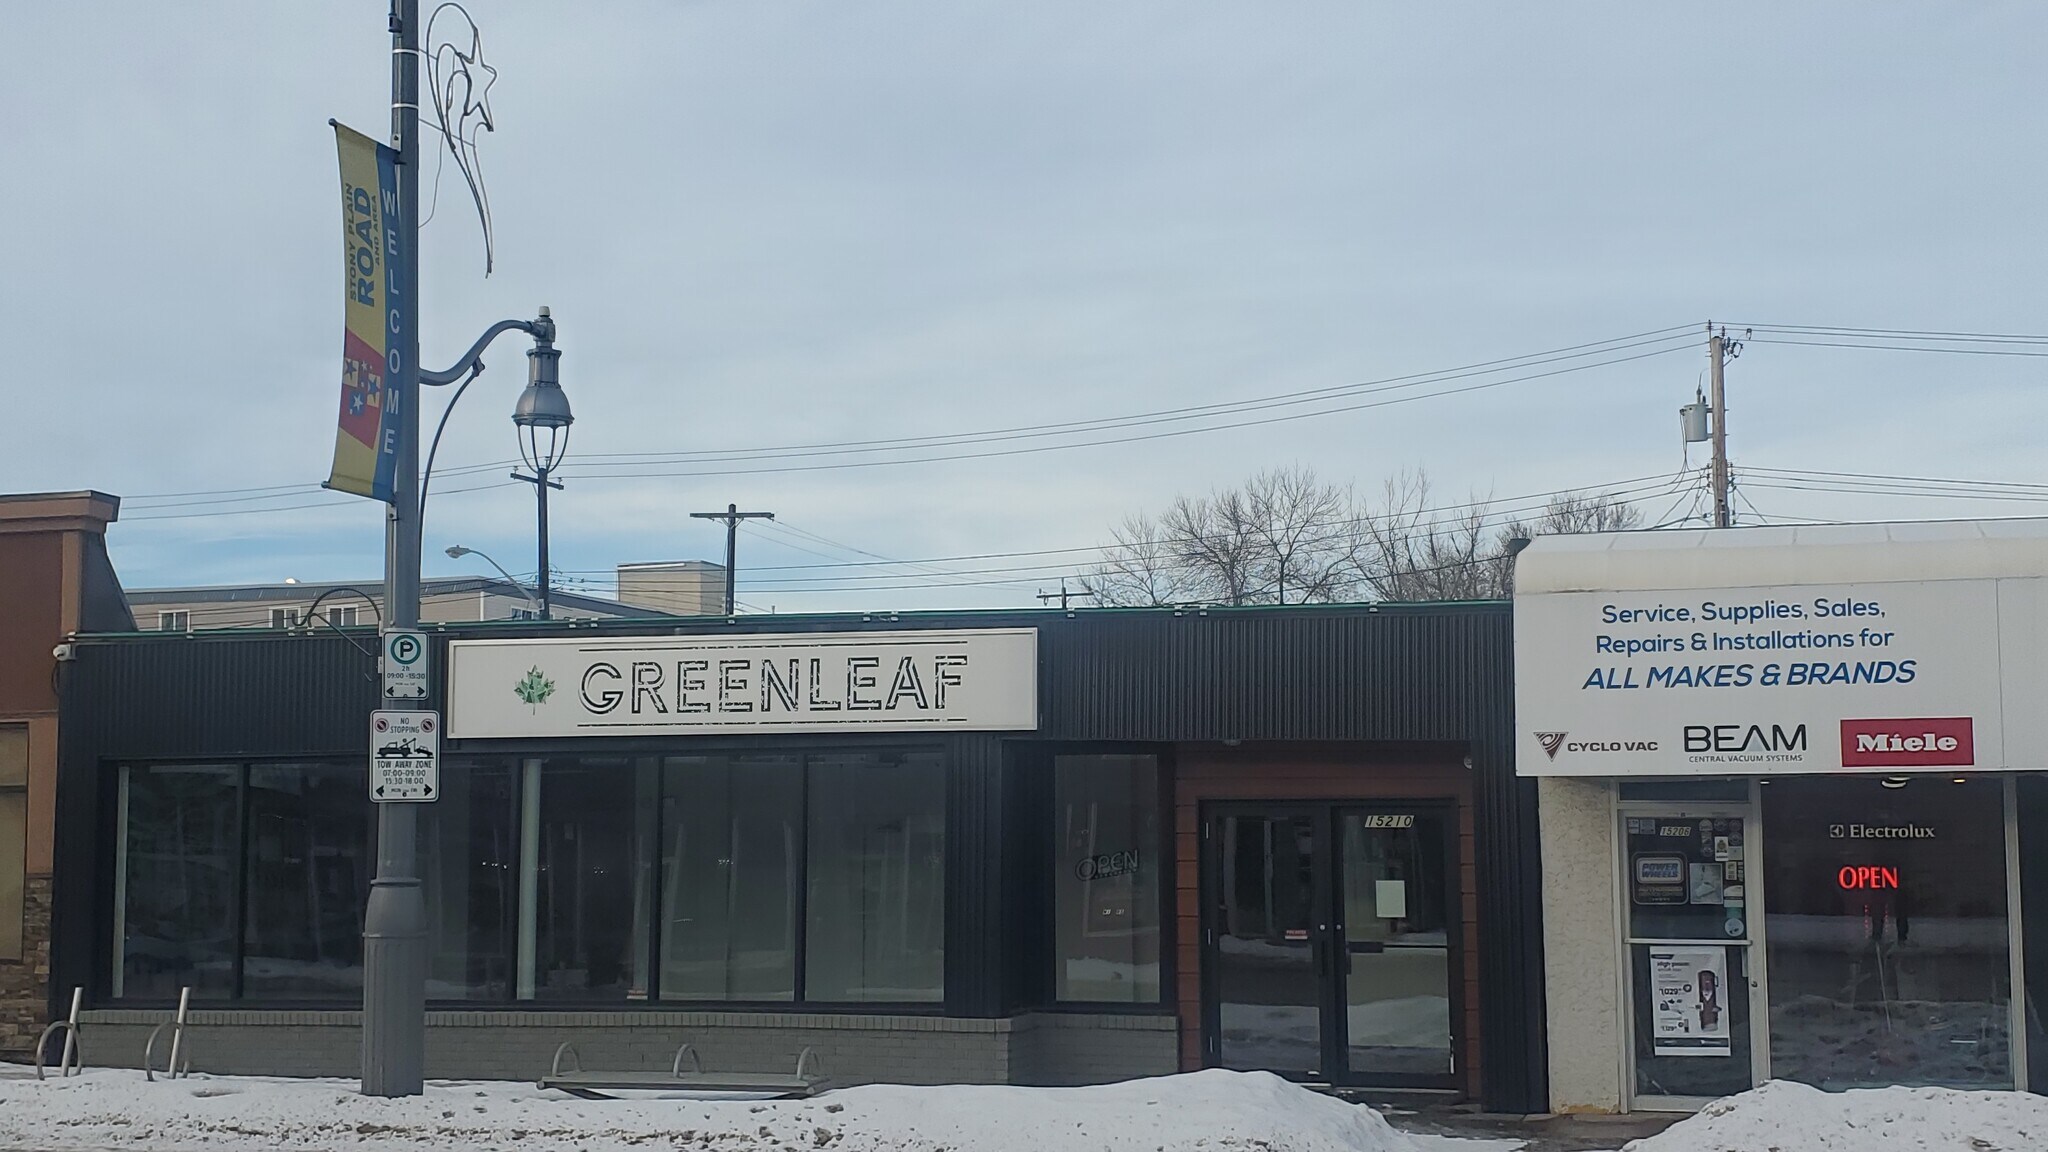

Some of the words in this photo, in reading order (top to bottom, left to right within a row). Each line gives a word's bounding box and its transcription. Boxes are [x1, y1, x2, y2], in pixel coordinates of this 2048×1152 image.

[345, 182, 355, 236] PLAIN
[370, 195, 379, 233] AREA
[353, 187, 375, 307] ROAD
[381, 188, 401, 455] WELCOME
[1601, 604, 1696, 623] Service,
[1701, 600, 1808, 624] Supplies,
[1813, 598, 1886, 619] Sales,
[400, 641, 414, 658] P
[1595, 635, 1685, 657] Repairs
[1691, 632, 1708, 651] &
[1712, 629, 1855, 651] Installations
[1859, 628, 1895, 647] for
[579, 655, 967, 715] GREENLEAF
[1581, 667, 1640, 690] ALL
[1646, 664, 1754, 689] MAKES
[1759, 663, 1781, 687] &
[1786, 659, 1917, 686] BRANDS
[389, 725, 420, 734] STOPPING
[400, 717, 410, 725] NO
[1567, 742, 1621, 752] CYCLO
[1624, 741, 1659, 752] VAC
[1684, 724, 1807, 753] BEAM
[1856, 733, 1958, 752] Miele
[377, 760, 392, 769] TOW
[394, 760, 413, 769] AWAY
[415, 760, 432, 768] ZONE
[1688, 755, 1726, 763] CENTRAL
[1766, 754, 1803, 762] SYSTEMS
[1368, 815, 1412, 827] 15210
[1661, 827, 1691, 836] 15206
[1850, 823, 1936, 838] Electrolux
[1075, 849, 1139, 881] OPEN
[1838, 866, 1899, 889] OPEN
